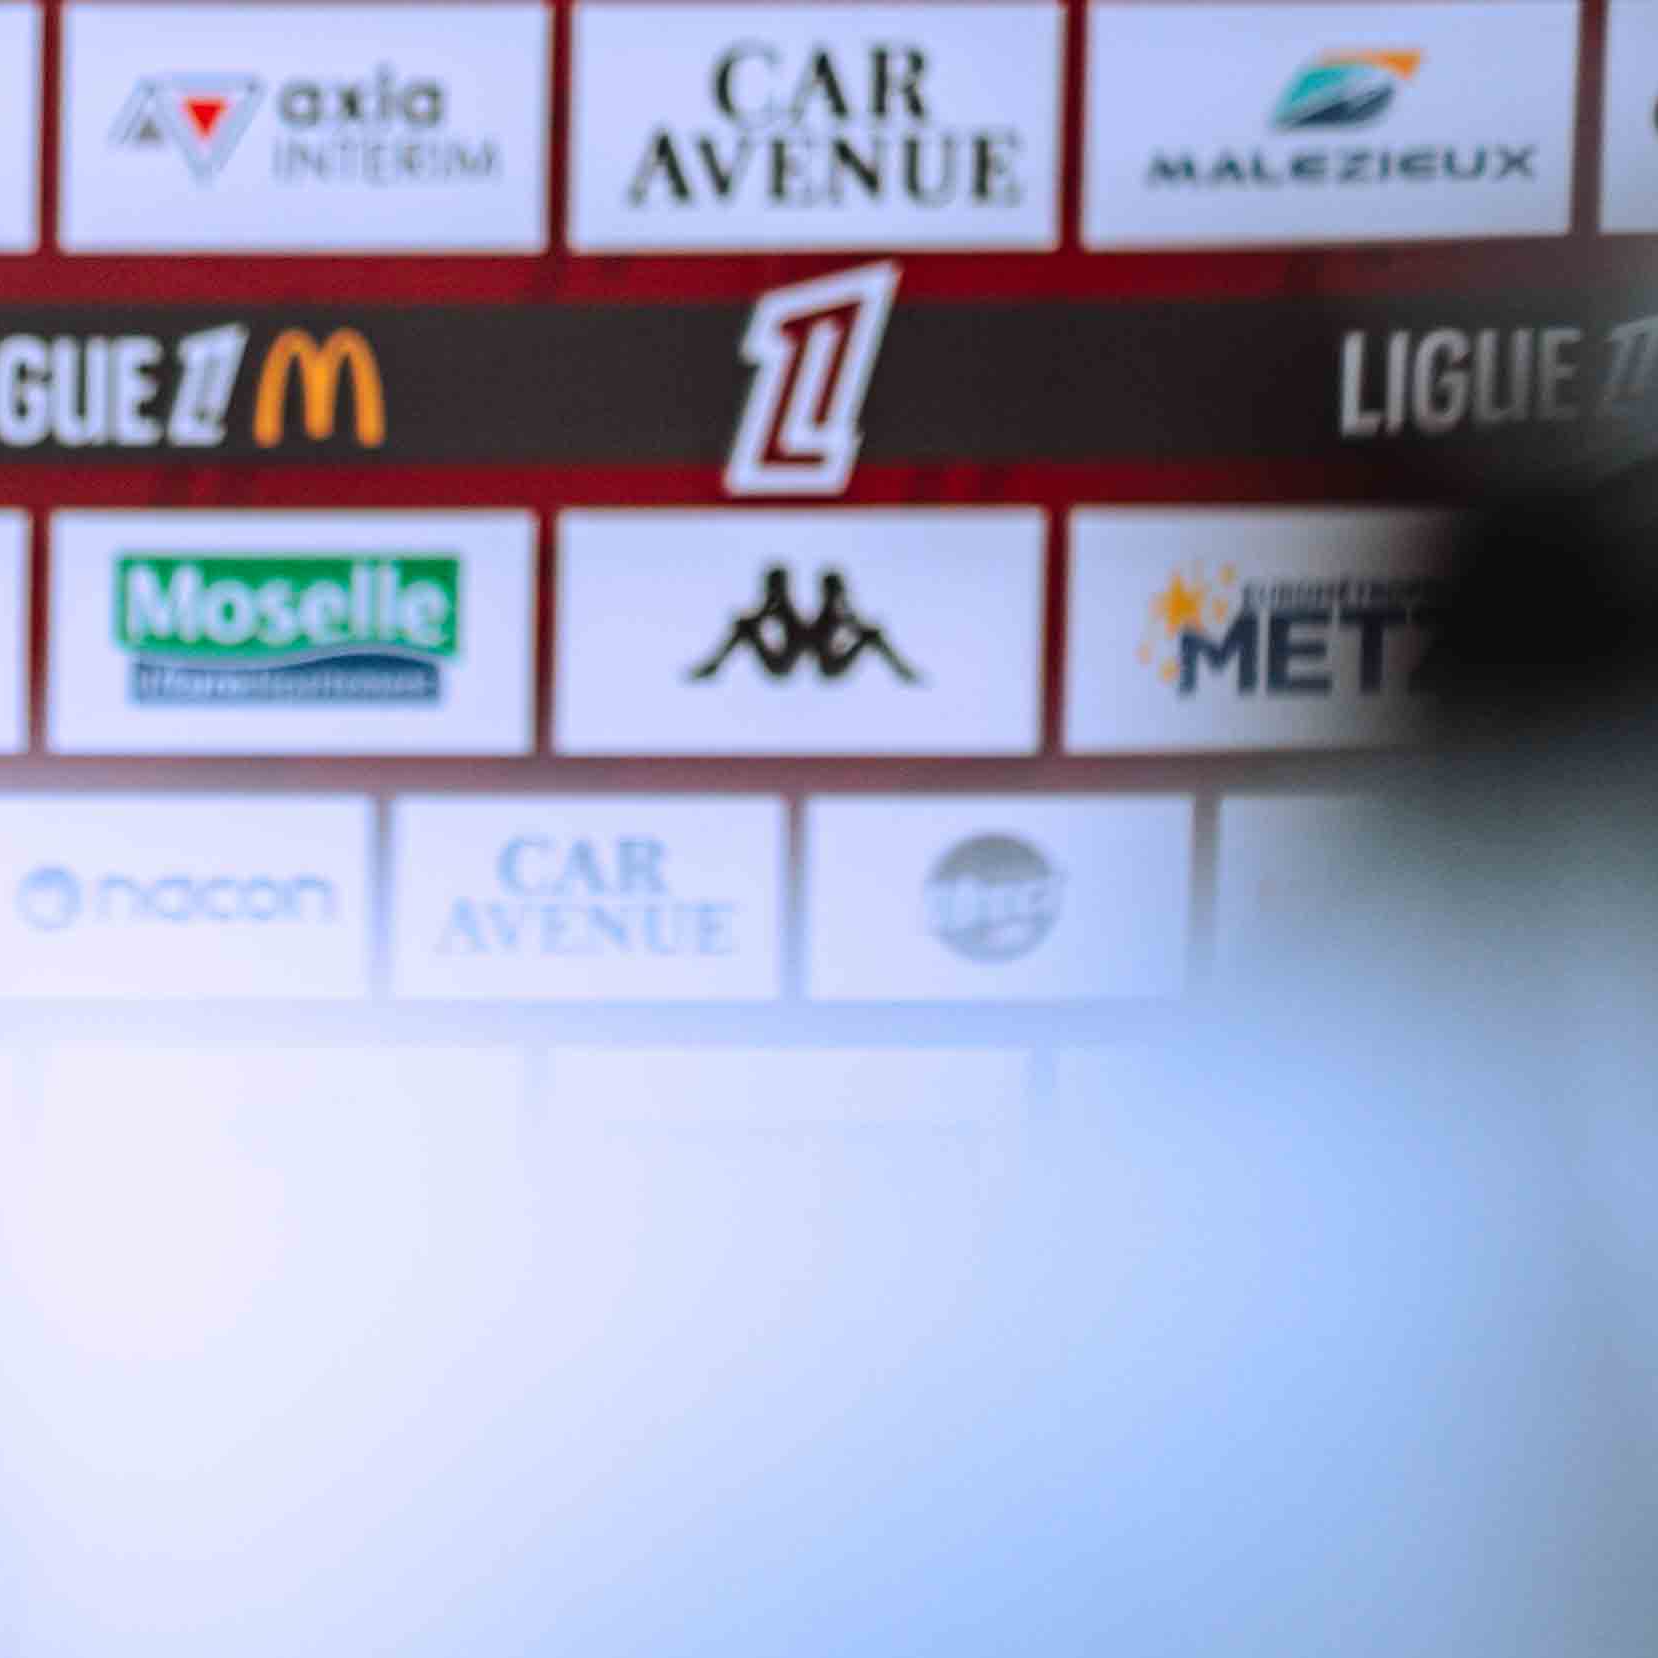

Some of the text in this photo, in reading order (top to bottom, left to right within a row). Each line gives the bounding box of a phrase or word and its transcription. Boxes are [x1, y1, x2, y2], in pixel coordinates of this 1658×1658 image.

[279, 69, 445, 129] axia
[713, 41, 930, 121] CAR
[273, 137, 501, 186] INTERIM
[630, 129, 1024, 207] AVENUE
[1149, 145, 1539, 189] MALEZIEUX
[128, 564, 450, 645] Moselle
[1179, 606, 1419, 693] MET
[96, 870, 336, 924] nacon
[497, 837, 668, 897] CAR
[437, 901, 739, 957] AVENUE
